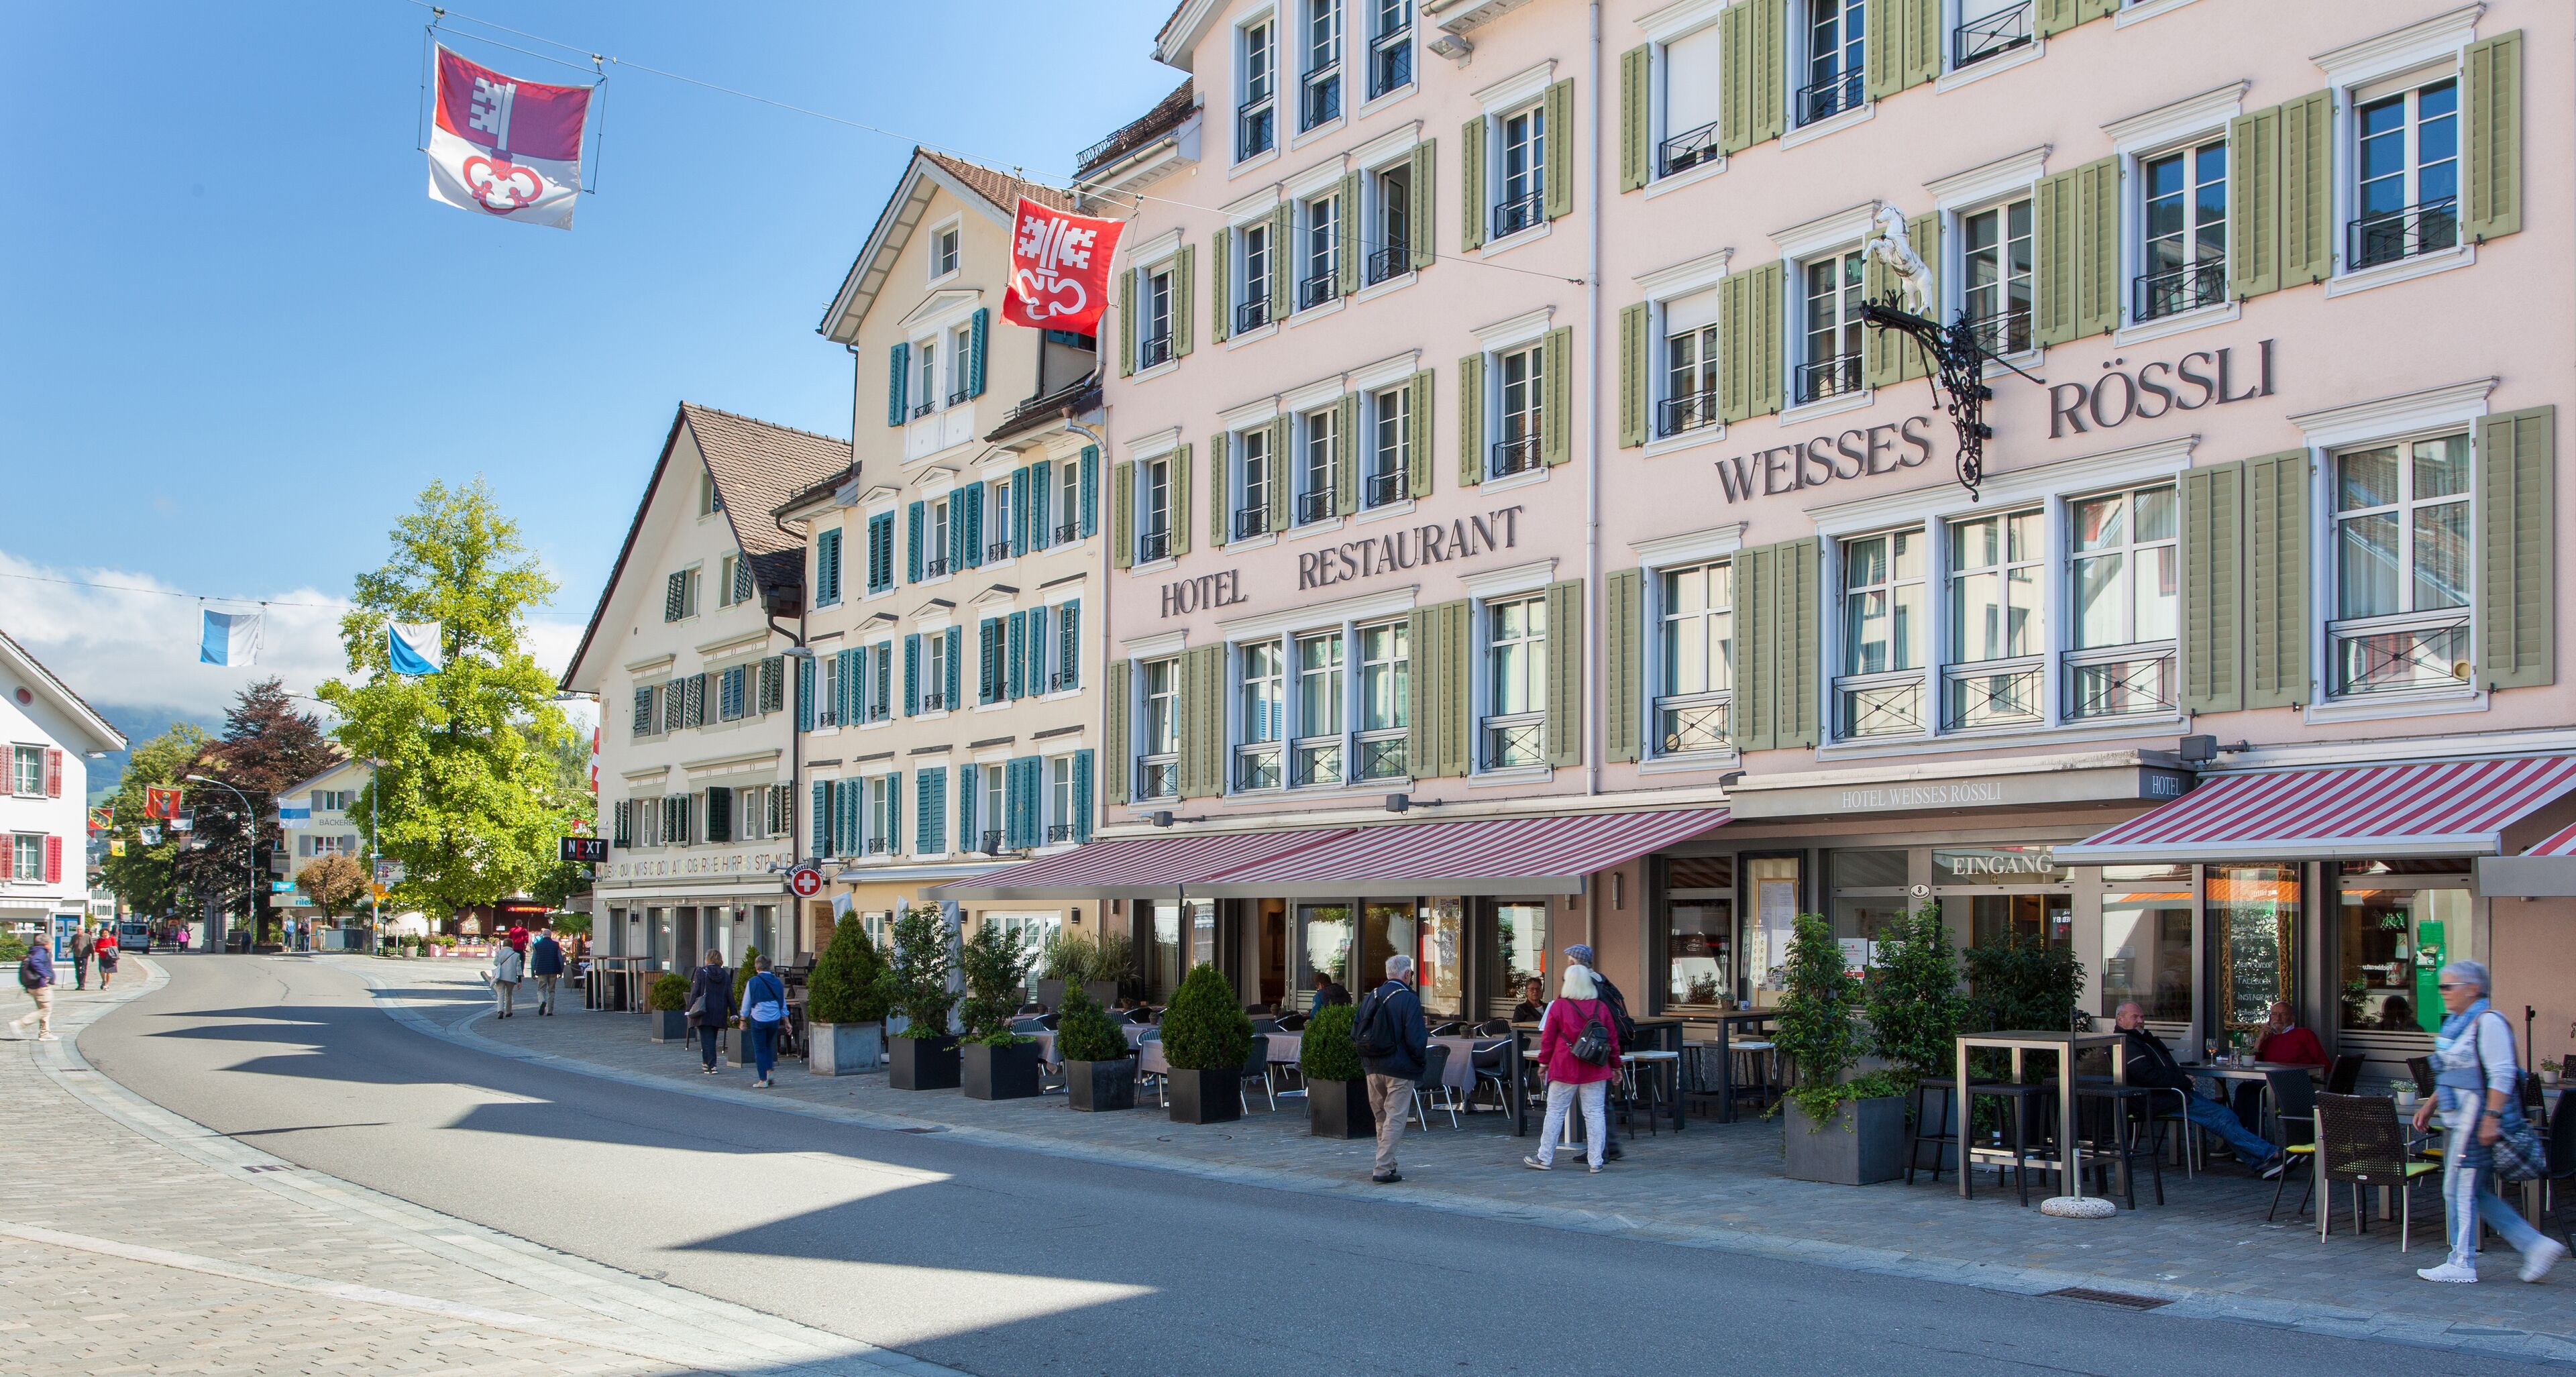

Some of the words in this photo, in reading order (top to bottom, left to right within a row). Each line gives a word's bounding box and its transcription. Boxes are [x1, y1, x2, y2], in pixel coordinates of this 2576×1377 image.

[1714, 416, 1931, 504] WEISSES
[2047, 339, 2275, 440] RÖSSLI
[1161, 569, 1248, 618] HOTEL
[1298, 504, 1523, 591] RESTAURANT
[1842, 789, 1886, 808] HOTEL
[1889, 785, 1947, 806] WEISSES
[1950, 781, 2001, 802] RÖSSLI
[2152, 775, 2182, 795] HOTEL
[319, 818, 356, 826] BÄCKERE
[568, 840, 602, 859] NEXT
[1951, 855, 2053, 875] EINGANG
[1917, 885, 1923, 894] 8
